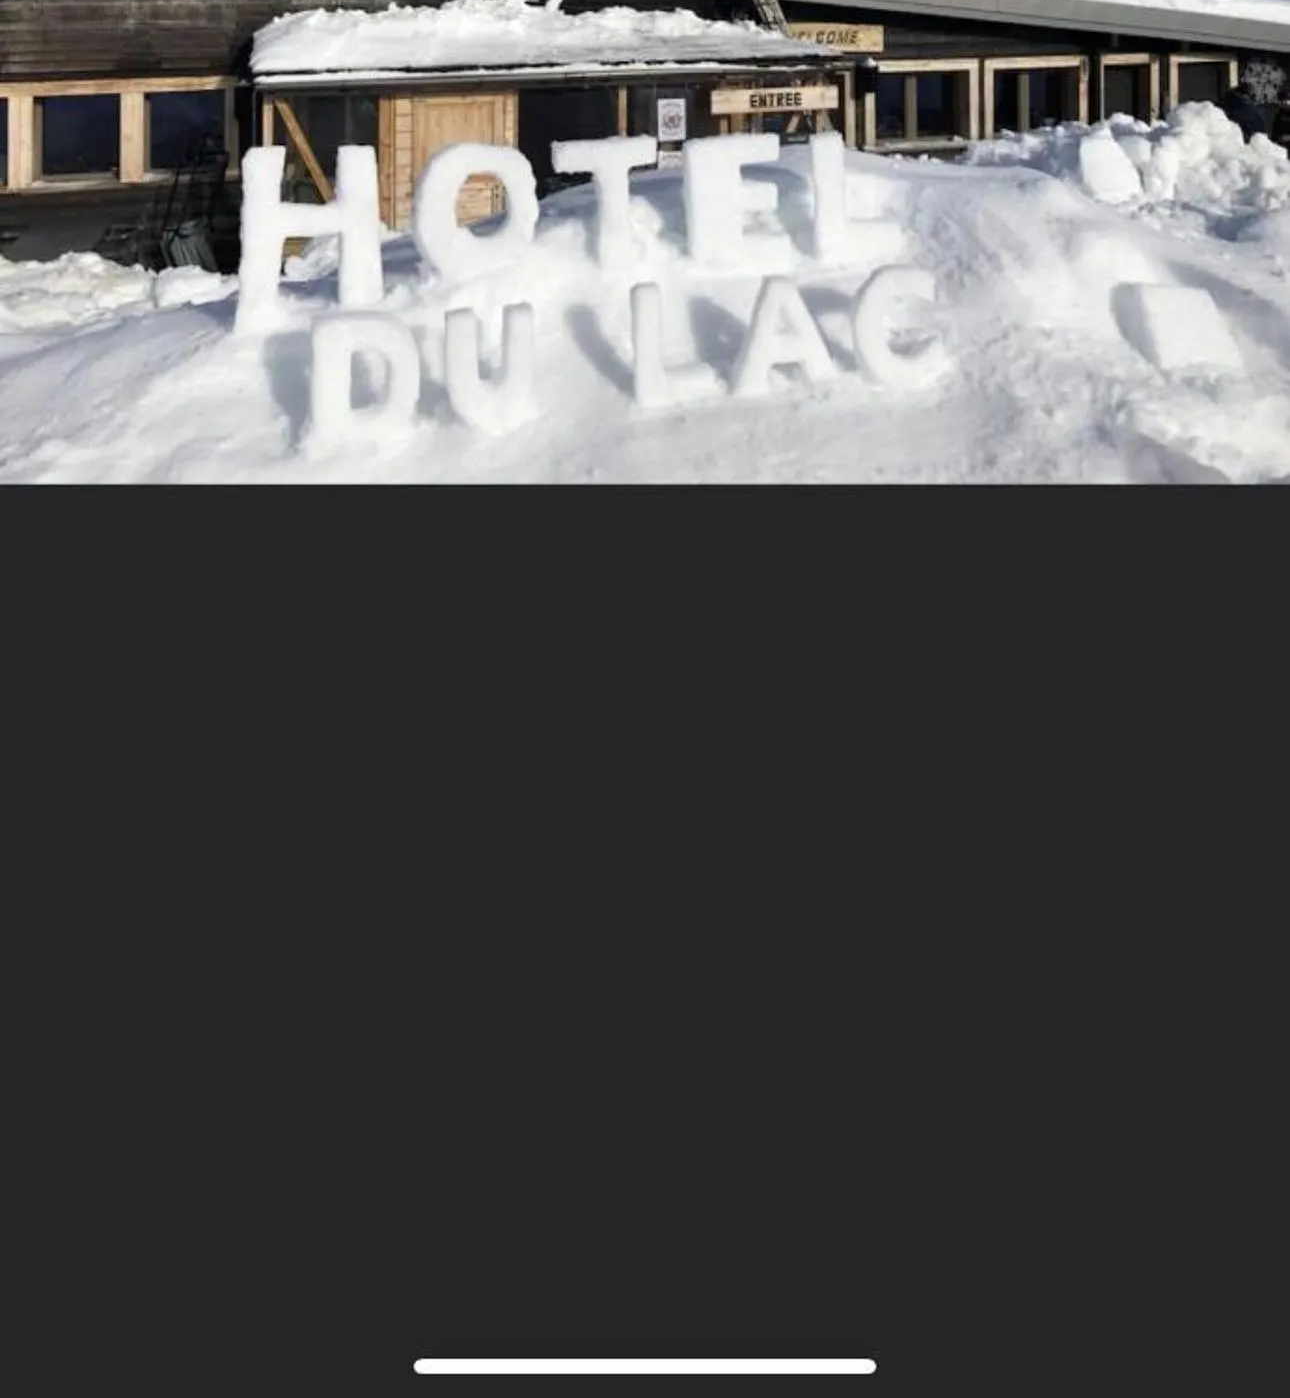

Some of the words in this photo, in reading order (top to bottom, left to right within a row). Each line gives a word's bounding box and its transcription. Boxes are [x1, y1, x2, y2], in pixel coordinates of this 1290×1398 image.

[750, 92, 802, 108] ENTREE
[235, 132, 903, 332] HOTEL
[309, 302, 536, 440] DU
[630, 265, 955, 402] LAC
